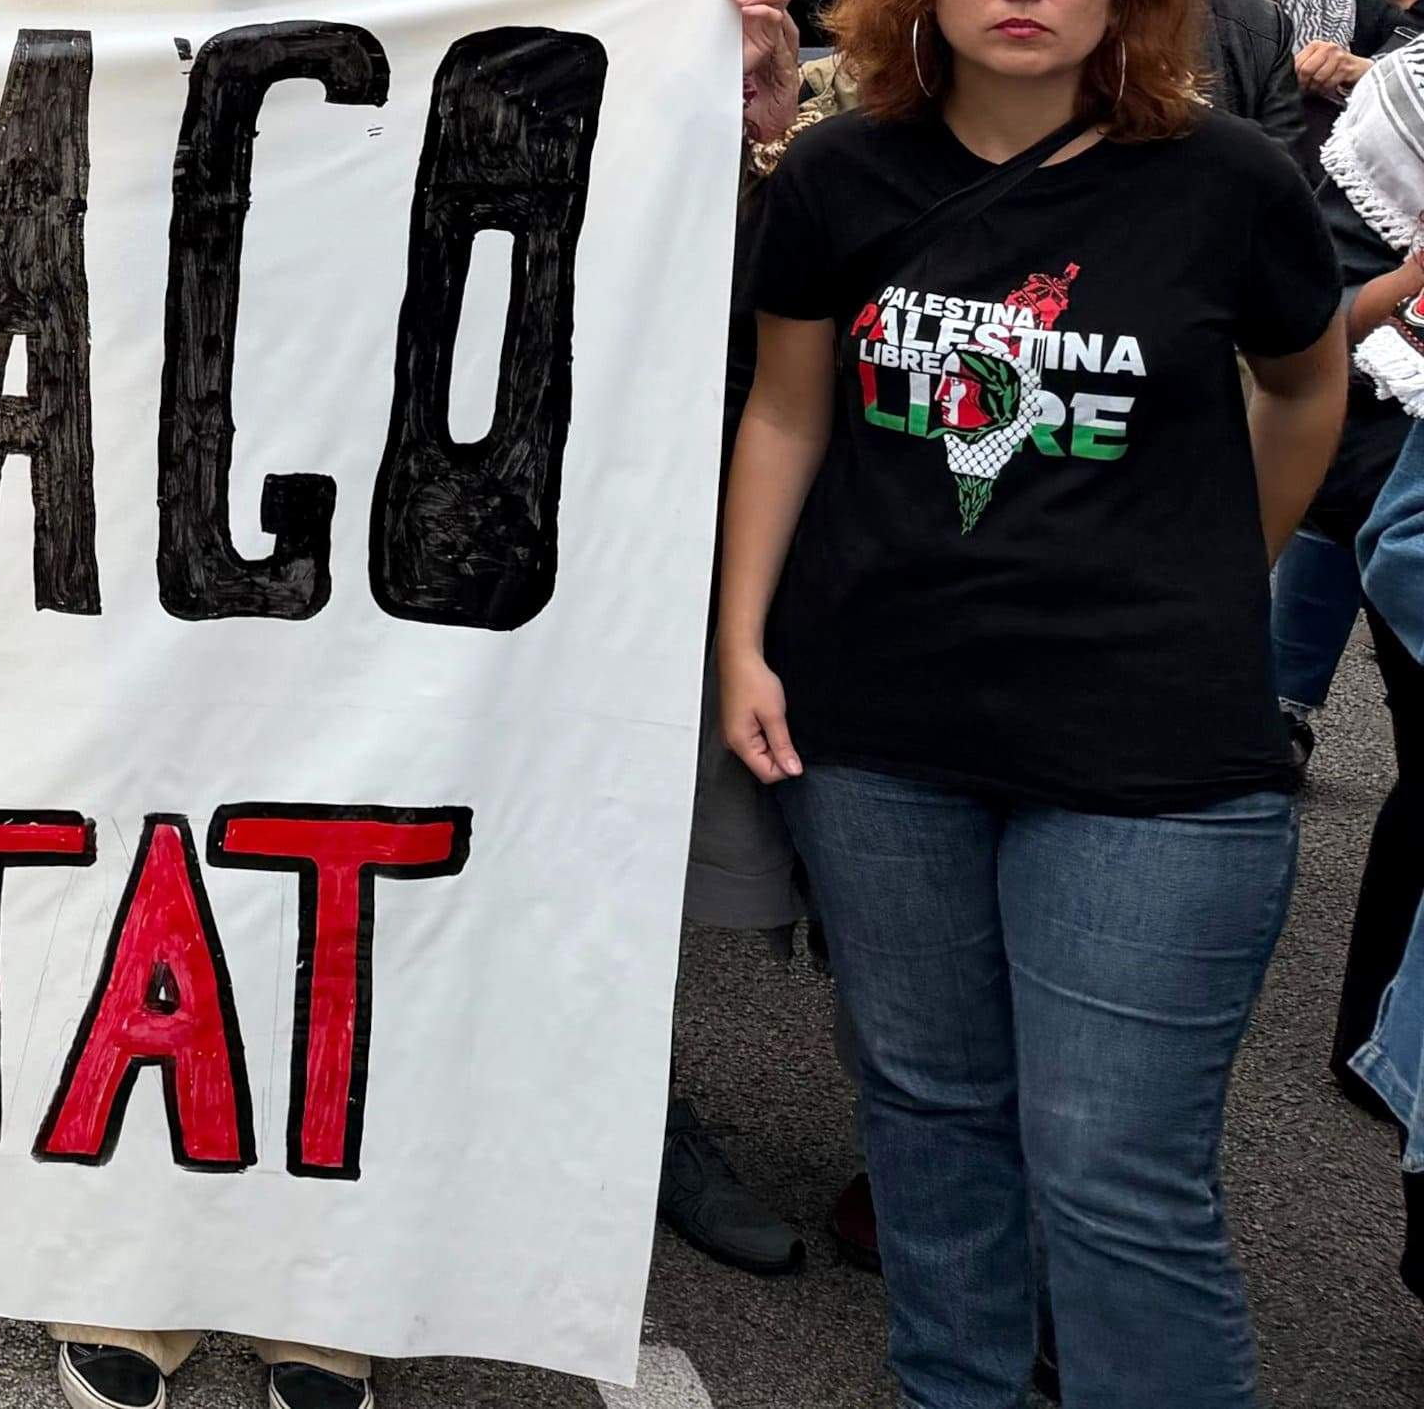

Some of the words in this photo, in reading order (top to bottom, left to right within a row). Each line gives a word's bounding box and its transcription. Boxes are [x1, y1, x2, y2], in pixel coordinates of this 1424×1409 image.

[877, 284, 1035, 329] PALESTINA
[850, 302, 1148, 377] PALESTINA
[858, 338, 944, 376] LIBRE
[857, 361, 1136, 461] LIRE
